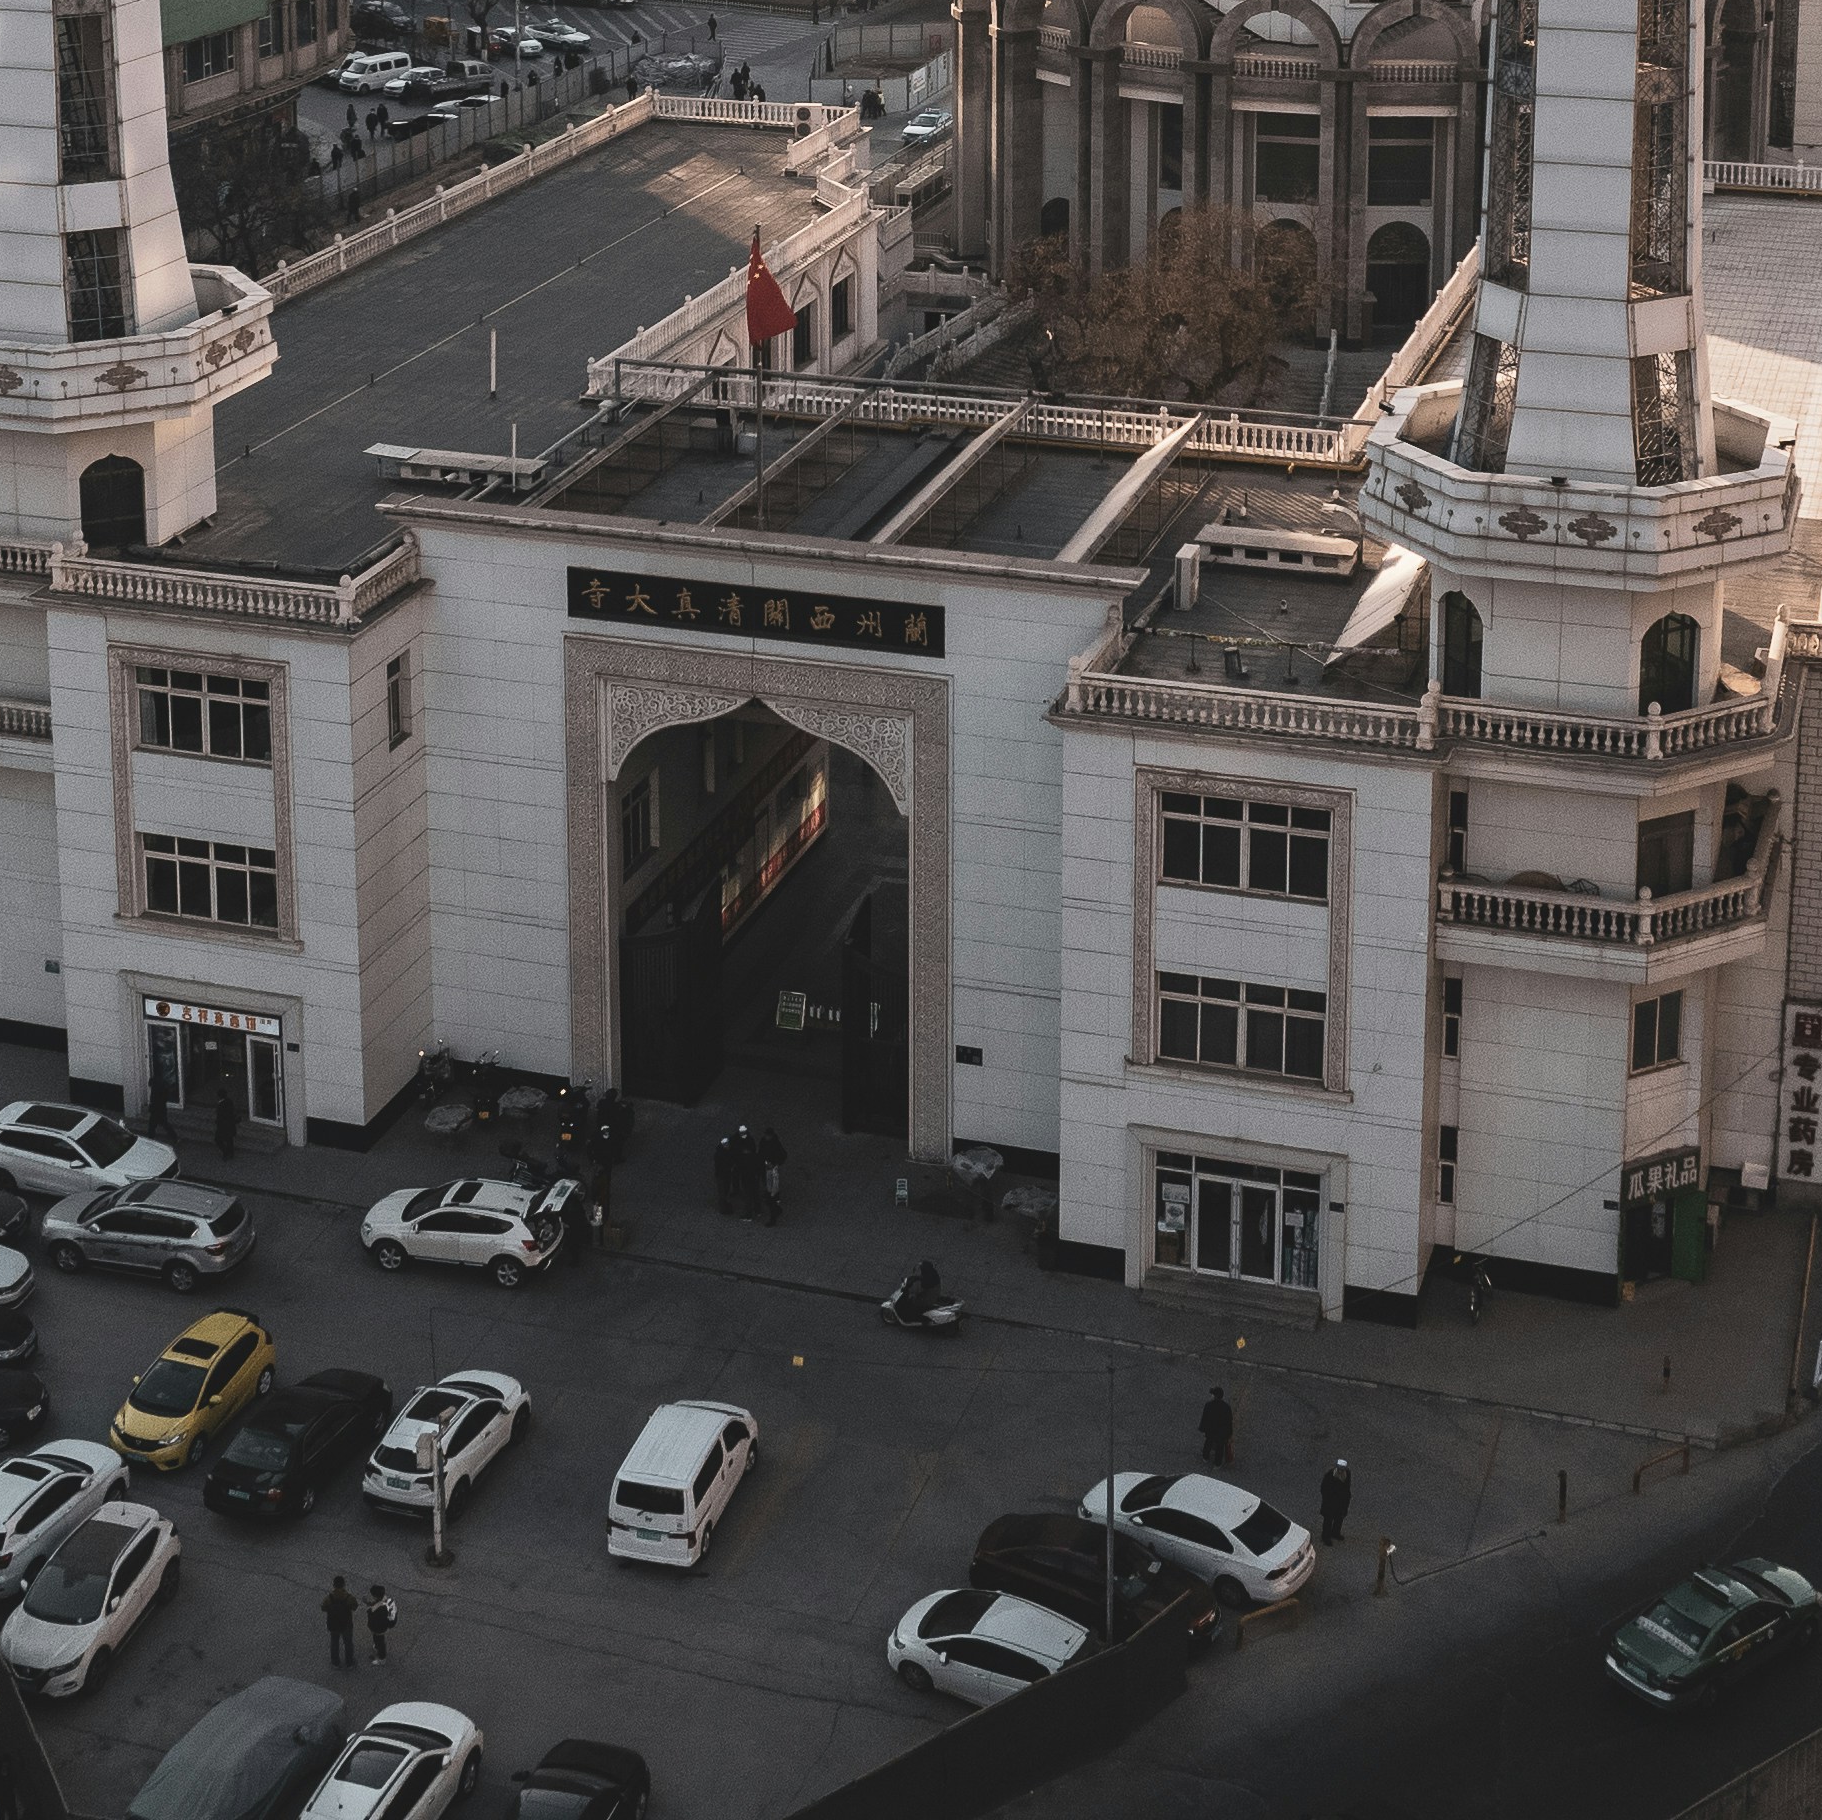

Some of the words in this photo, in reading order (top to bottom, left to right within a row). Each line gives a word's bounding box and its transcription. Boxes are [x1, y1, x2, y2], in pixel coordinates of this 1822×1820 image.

[1787, 1053, 1821, 1177] 专业药房
[1627, 1155, 1698, 1201] 瓜果礼品
